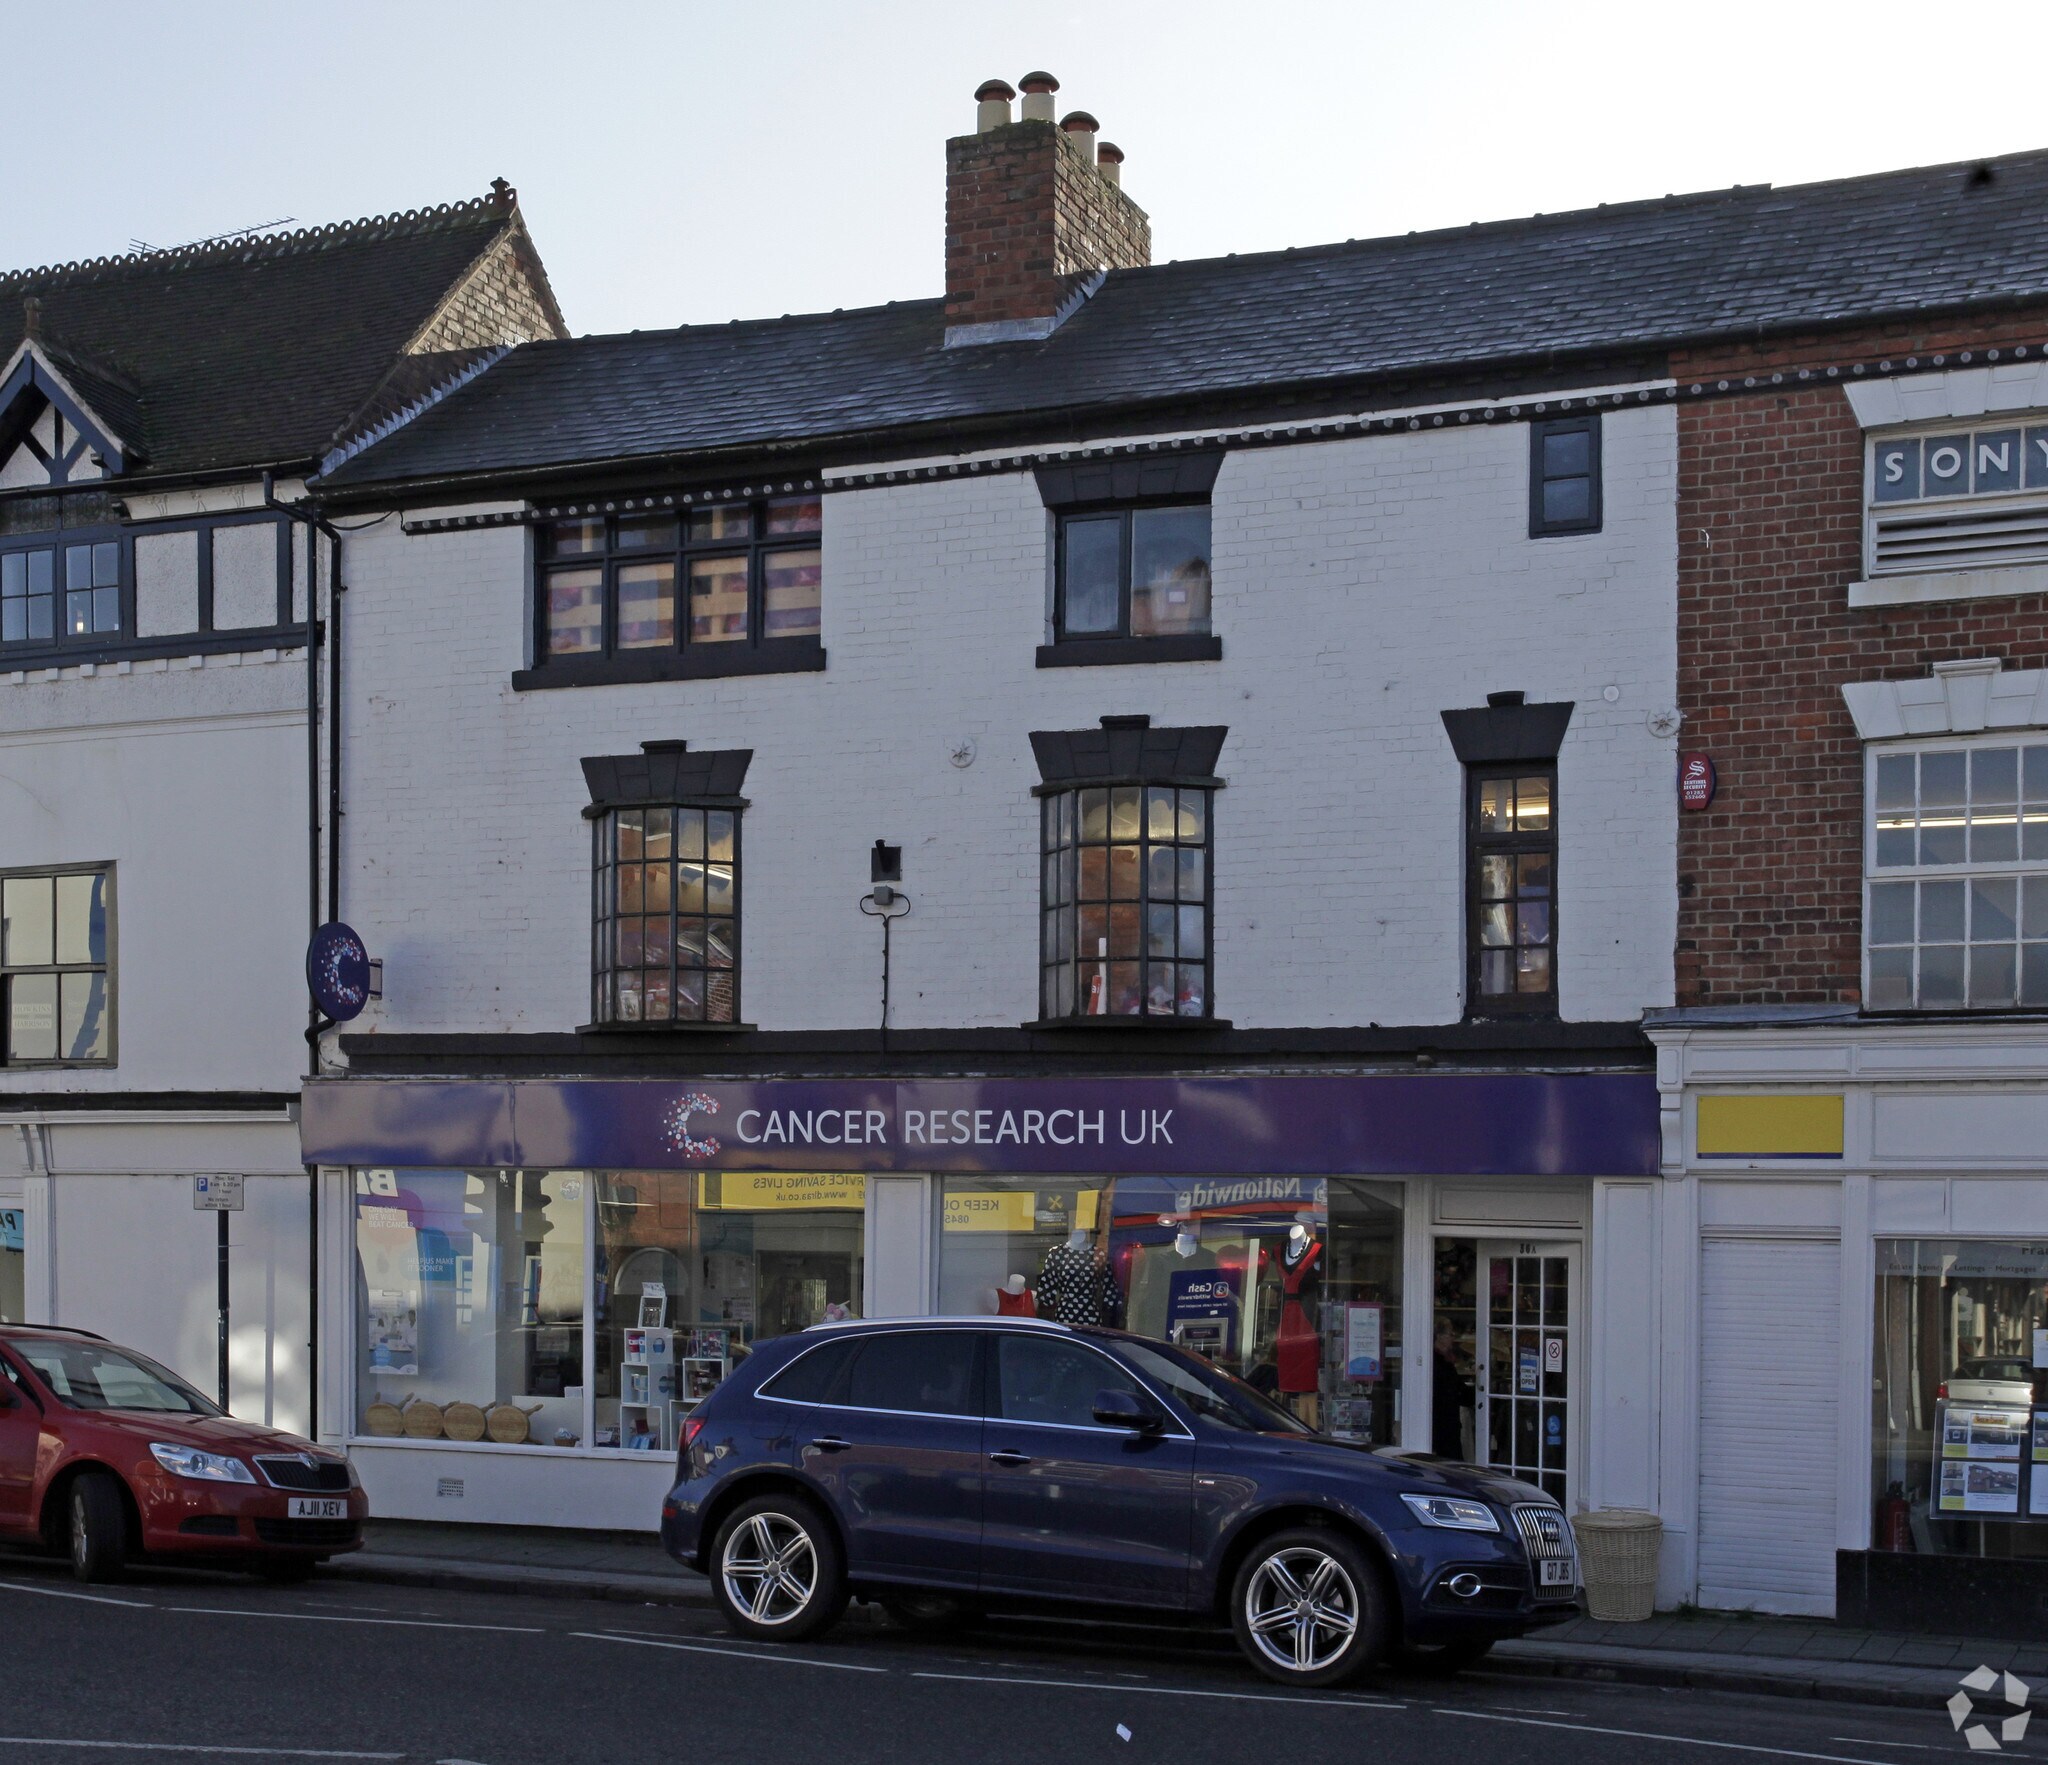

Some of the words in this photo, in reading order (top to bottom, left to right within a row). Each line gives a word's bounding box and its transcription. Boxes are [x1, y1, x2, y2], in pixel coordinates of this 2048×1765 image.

[736, 1109, 887, 1144] CANCER
[905, 1109, 1104, 1144] RESEARCH
[1120, 1109, 1174, 1144] UK
[1954, 1265, 1985, 1273] Lettings
[1995, 1265, 2037, 1273] Mortgages
[298, 1500, 320, 1516] AJ11
[322, 1501, 341, 1516] XEV
